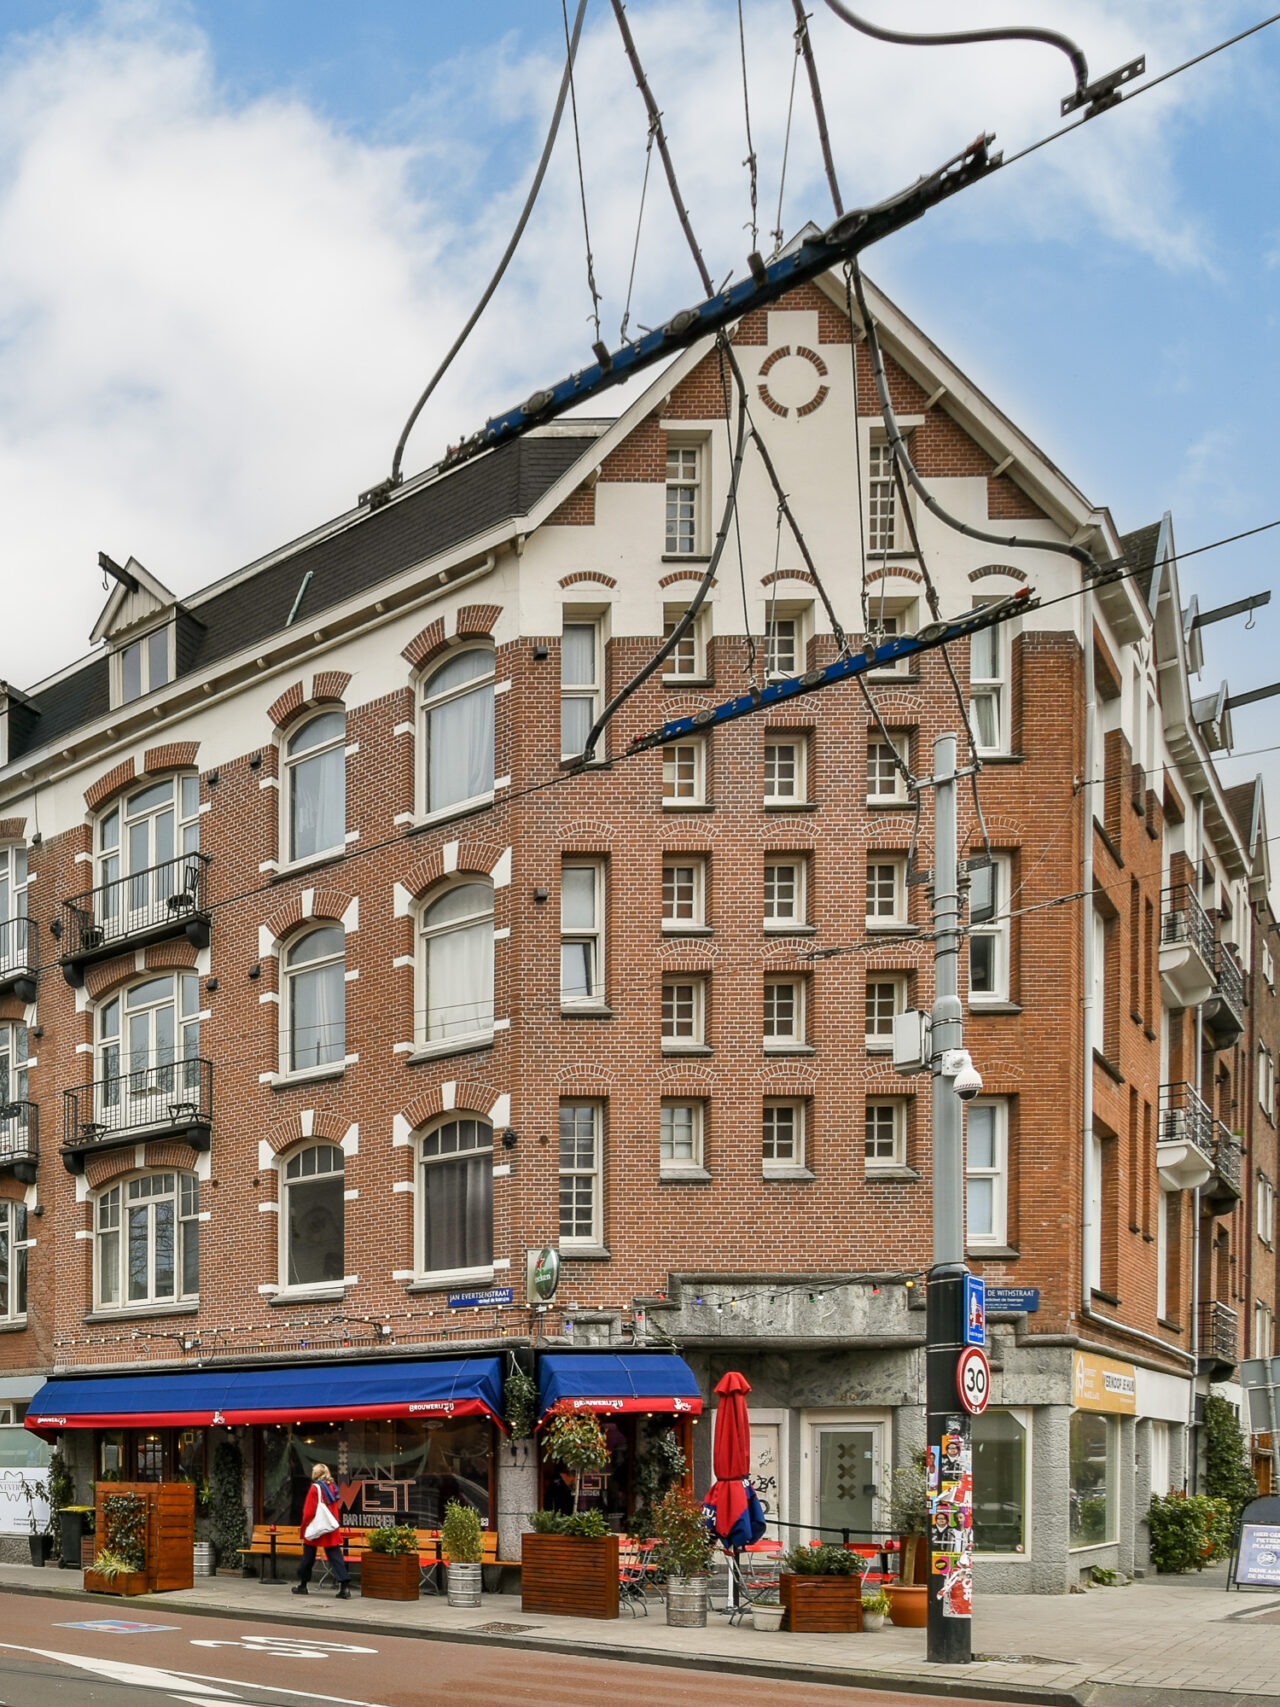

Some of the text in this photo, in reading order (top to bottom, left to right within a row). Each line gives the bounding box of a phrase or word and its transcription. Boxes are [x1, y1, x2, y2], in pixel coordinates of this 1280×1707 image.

[449, 1290, 510, 1302] JAN EVERTSENSTRAAT
[987, 1289, 1035, 1297] DE WITHSTRAAT
[966, 1367, 985, 1393] 30
[342, 1513, 358, 1526] BAR
[362, 1515, 396, 1527] KITCHEN
